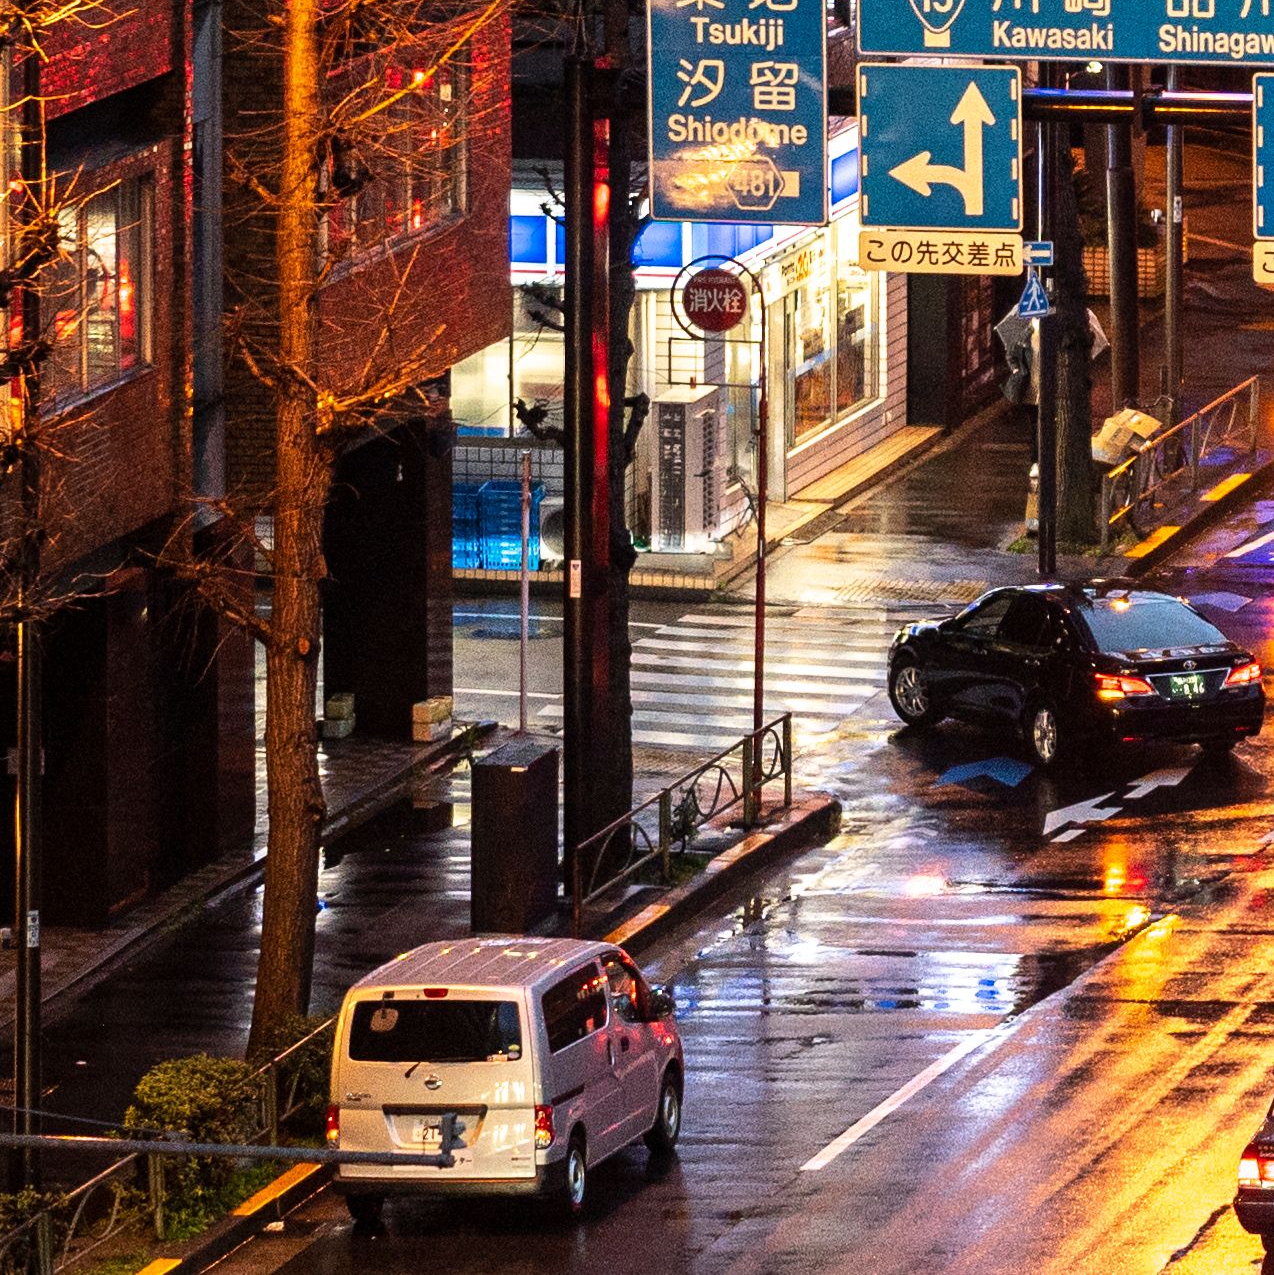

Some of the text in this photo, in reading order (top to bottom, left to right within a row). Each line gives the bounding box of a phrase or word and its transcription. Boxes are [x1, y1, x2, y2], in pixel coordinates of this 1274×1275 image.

[690, 16, 785, 51] Tsukiji
[992, 21, 1114, 51] Kawasaki
[675, 59, 800, 111] 汐留
[667, 113, 808, 146] Shiodome
[733, 169, 775, 197] 481
[866, 237, 1019, 271] この先交差点
[689, 287, 743, 313] 消火栓
